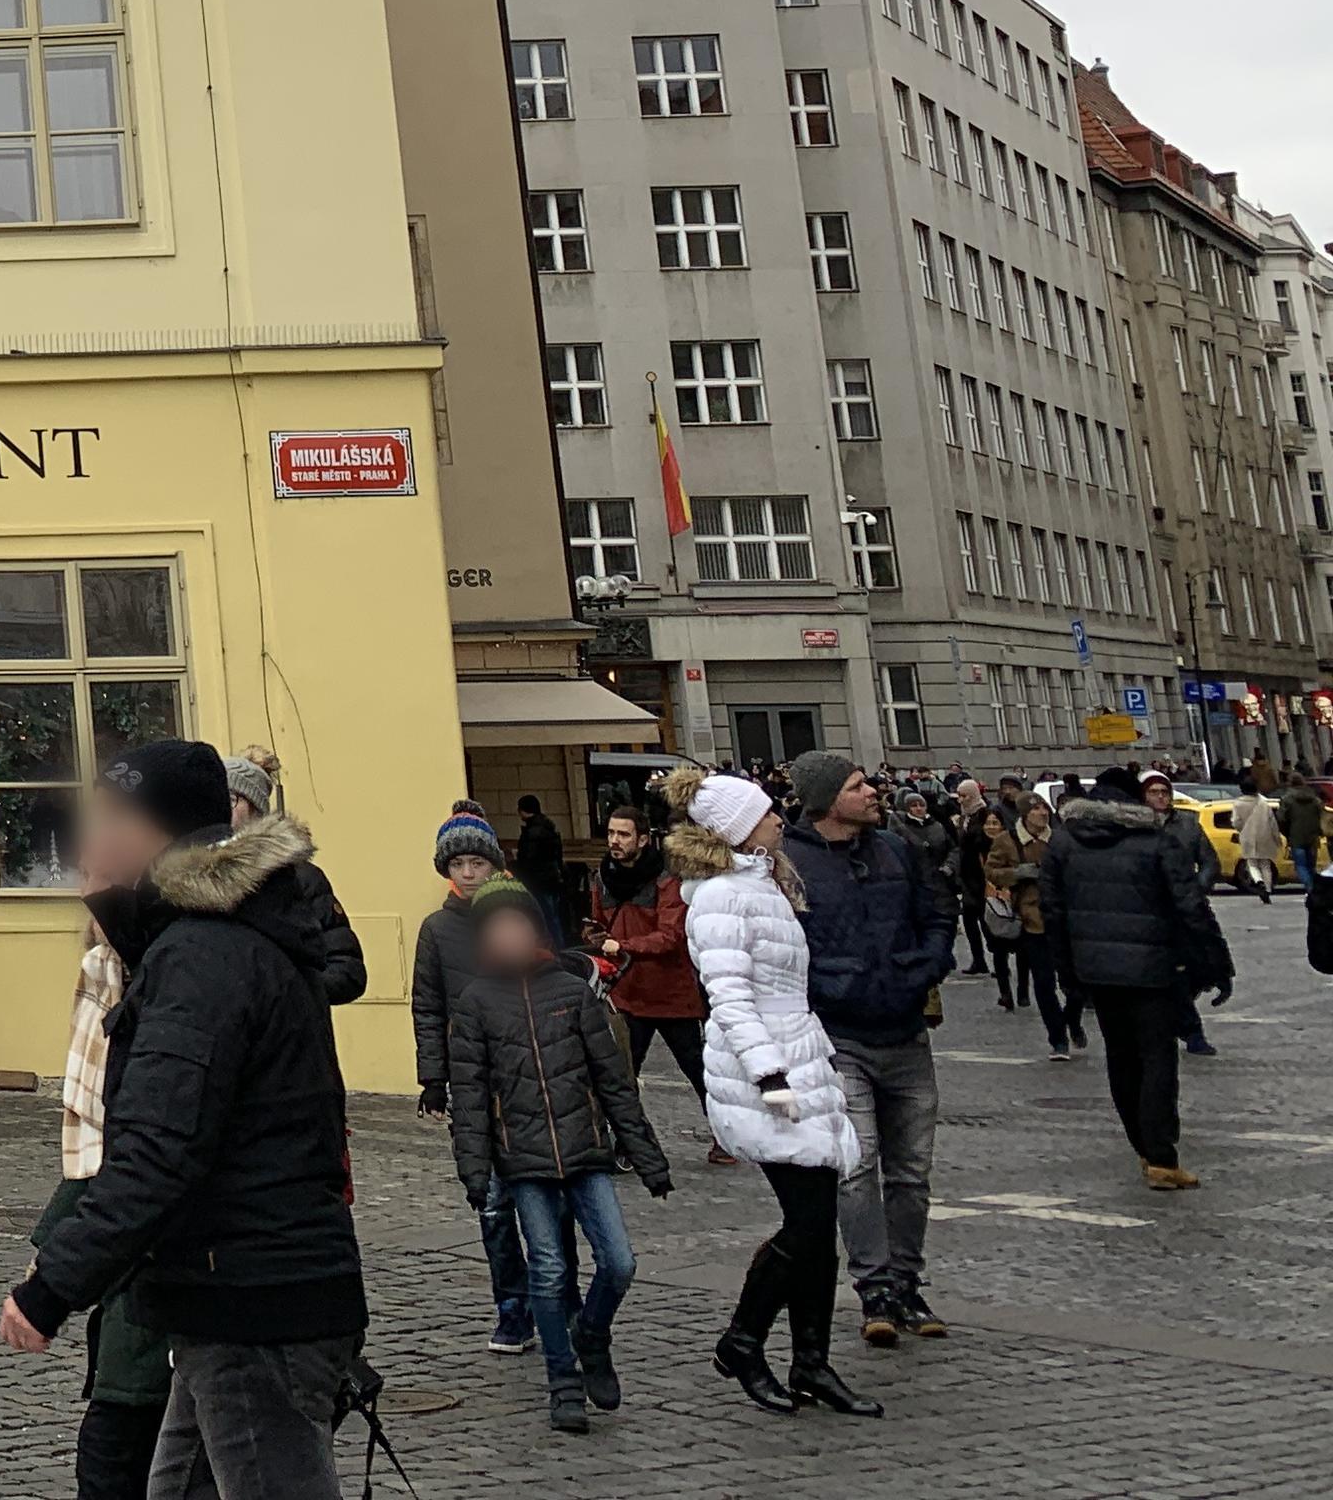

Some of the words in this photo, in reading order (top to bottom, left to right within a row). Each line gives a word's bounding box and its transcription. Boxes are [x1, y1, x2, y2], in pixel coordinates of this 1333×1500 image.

[290, 444, 394, 467] MIKULÁŠSKÁ
[291, 469, 320, 482] STARÉ
[321, 468, 352, 482] MĚSTO
[359, 469, 390, 481] PRAHA
[391, 469, 397, 480] 1
[1075, 625, 1085, 648] P
[1127, 691, 1140, 708] P
[104, 761, 143, 793] 23
